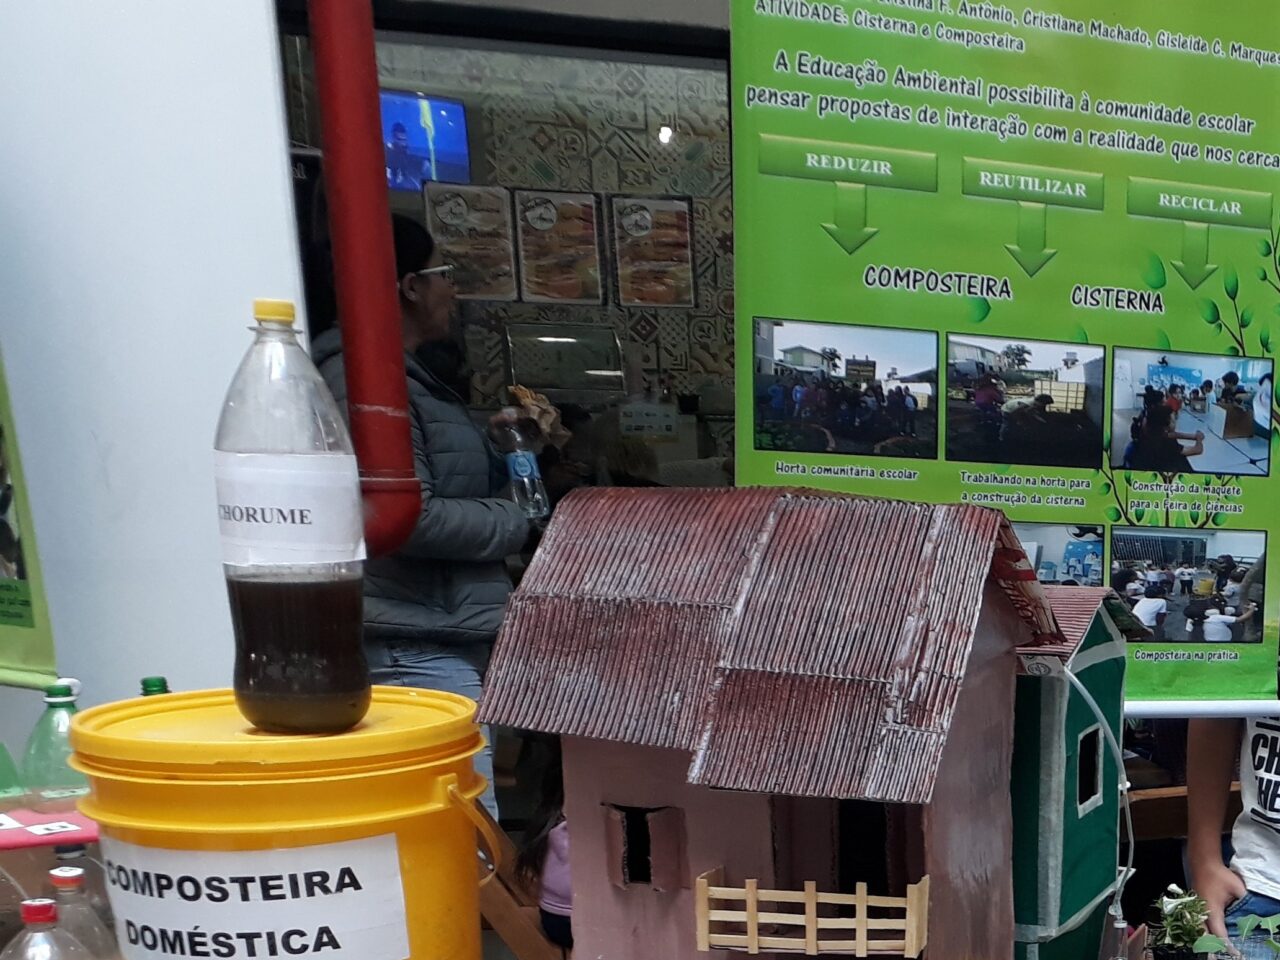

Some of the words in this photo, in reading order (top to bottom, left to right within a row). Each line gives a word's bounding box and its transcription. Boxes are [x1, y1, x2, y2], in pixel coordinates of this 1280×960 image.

[755, 0, 848, 24] ATIVIDADE:
[854, 11, 916, 34] Cisterna
[922, 24, 930, 36] e
[935, 23, 1024, 51] Composteira
[959, 4, 1018, 25] Antônio,
[1023, 10, 1084, 33] Cristiane
[1091, 21, 1151, 46] Machado,
[1157, 32, 1208, 54] Gisleide
[1213, 40, 1225, 55] C.
[774, 51, 789, 72] A
[797, 52, 886, 87] Educação
[894, 66, 981, 97] Ambiental
[988, 83, 1074, 111] possibilita
[1080, 92, 1090, 112] à
[1096, 99, 1192, 126] comunidade
[1199, 114, 1254, 134] escolar
[746, 86, 811, 108] pensar
[818, 94, 910, 121] propostas
[917, 105, 939, 125] de
[946, 108, 1027, 139] interação
[1034, 124, 1067, 142] com
[1073, 128, 1082, 144] a
[1089, 129, 1164, 154] realidade
[1171, 142, 1199, 162] que
[1205, 147, 1232, 162] nos
[806, 152, 893, 176] REDUZIR
[980, 171, 1087, 198] REUTILIZAR
[1158, 193, 1242, 215] RECICLAR
[864, 265, 1012, 298] COMPOSTEIRA
[1071, 286, 1163, 313] CISTERNA
[776, 462, 806, 474] Horta
[880, 469, 918, 479] escolar
[960, 471, 1021, 485] Trabalhando
[1025, 477, 1037, 486] na
[1040, 475, 1066, 487] horta
[1069, 479, 1091, 490] para
[971, 491, 1026, 506] construção
[1030, 495, 1042, 504] da
[1045, 495, 1085, 505] cisterna
[1132, 480, 1185, 495] Construção
[1188, 485, 1200, 493] da
[1203, 486, 1241, 496] maquete
[1130, 500, 1150, 509] para
[1163, 499, 1187, 510] Feira
[1191, 502, 1201, 510] de
[1205, 501, 1243, 512] Ciências
[1134, 649, 1191, 661] Composteira
[1194, 651, 1204, 660] na
[107, 858, 363, 904] COMPOSTEIRA
[126, 919, 341, 959] DOMÉSTICA
